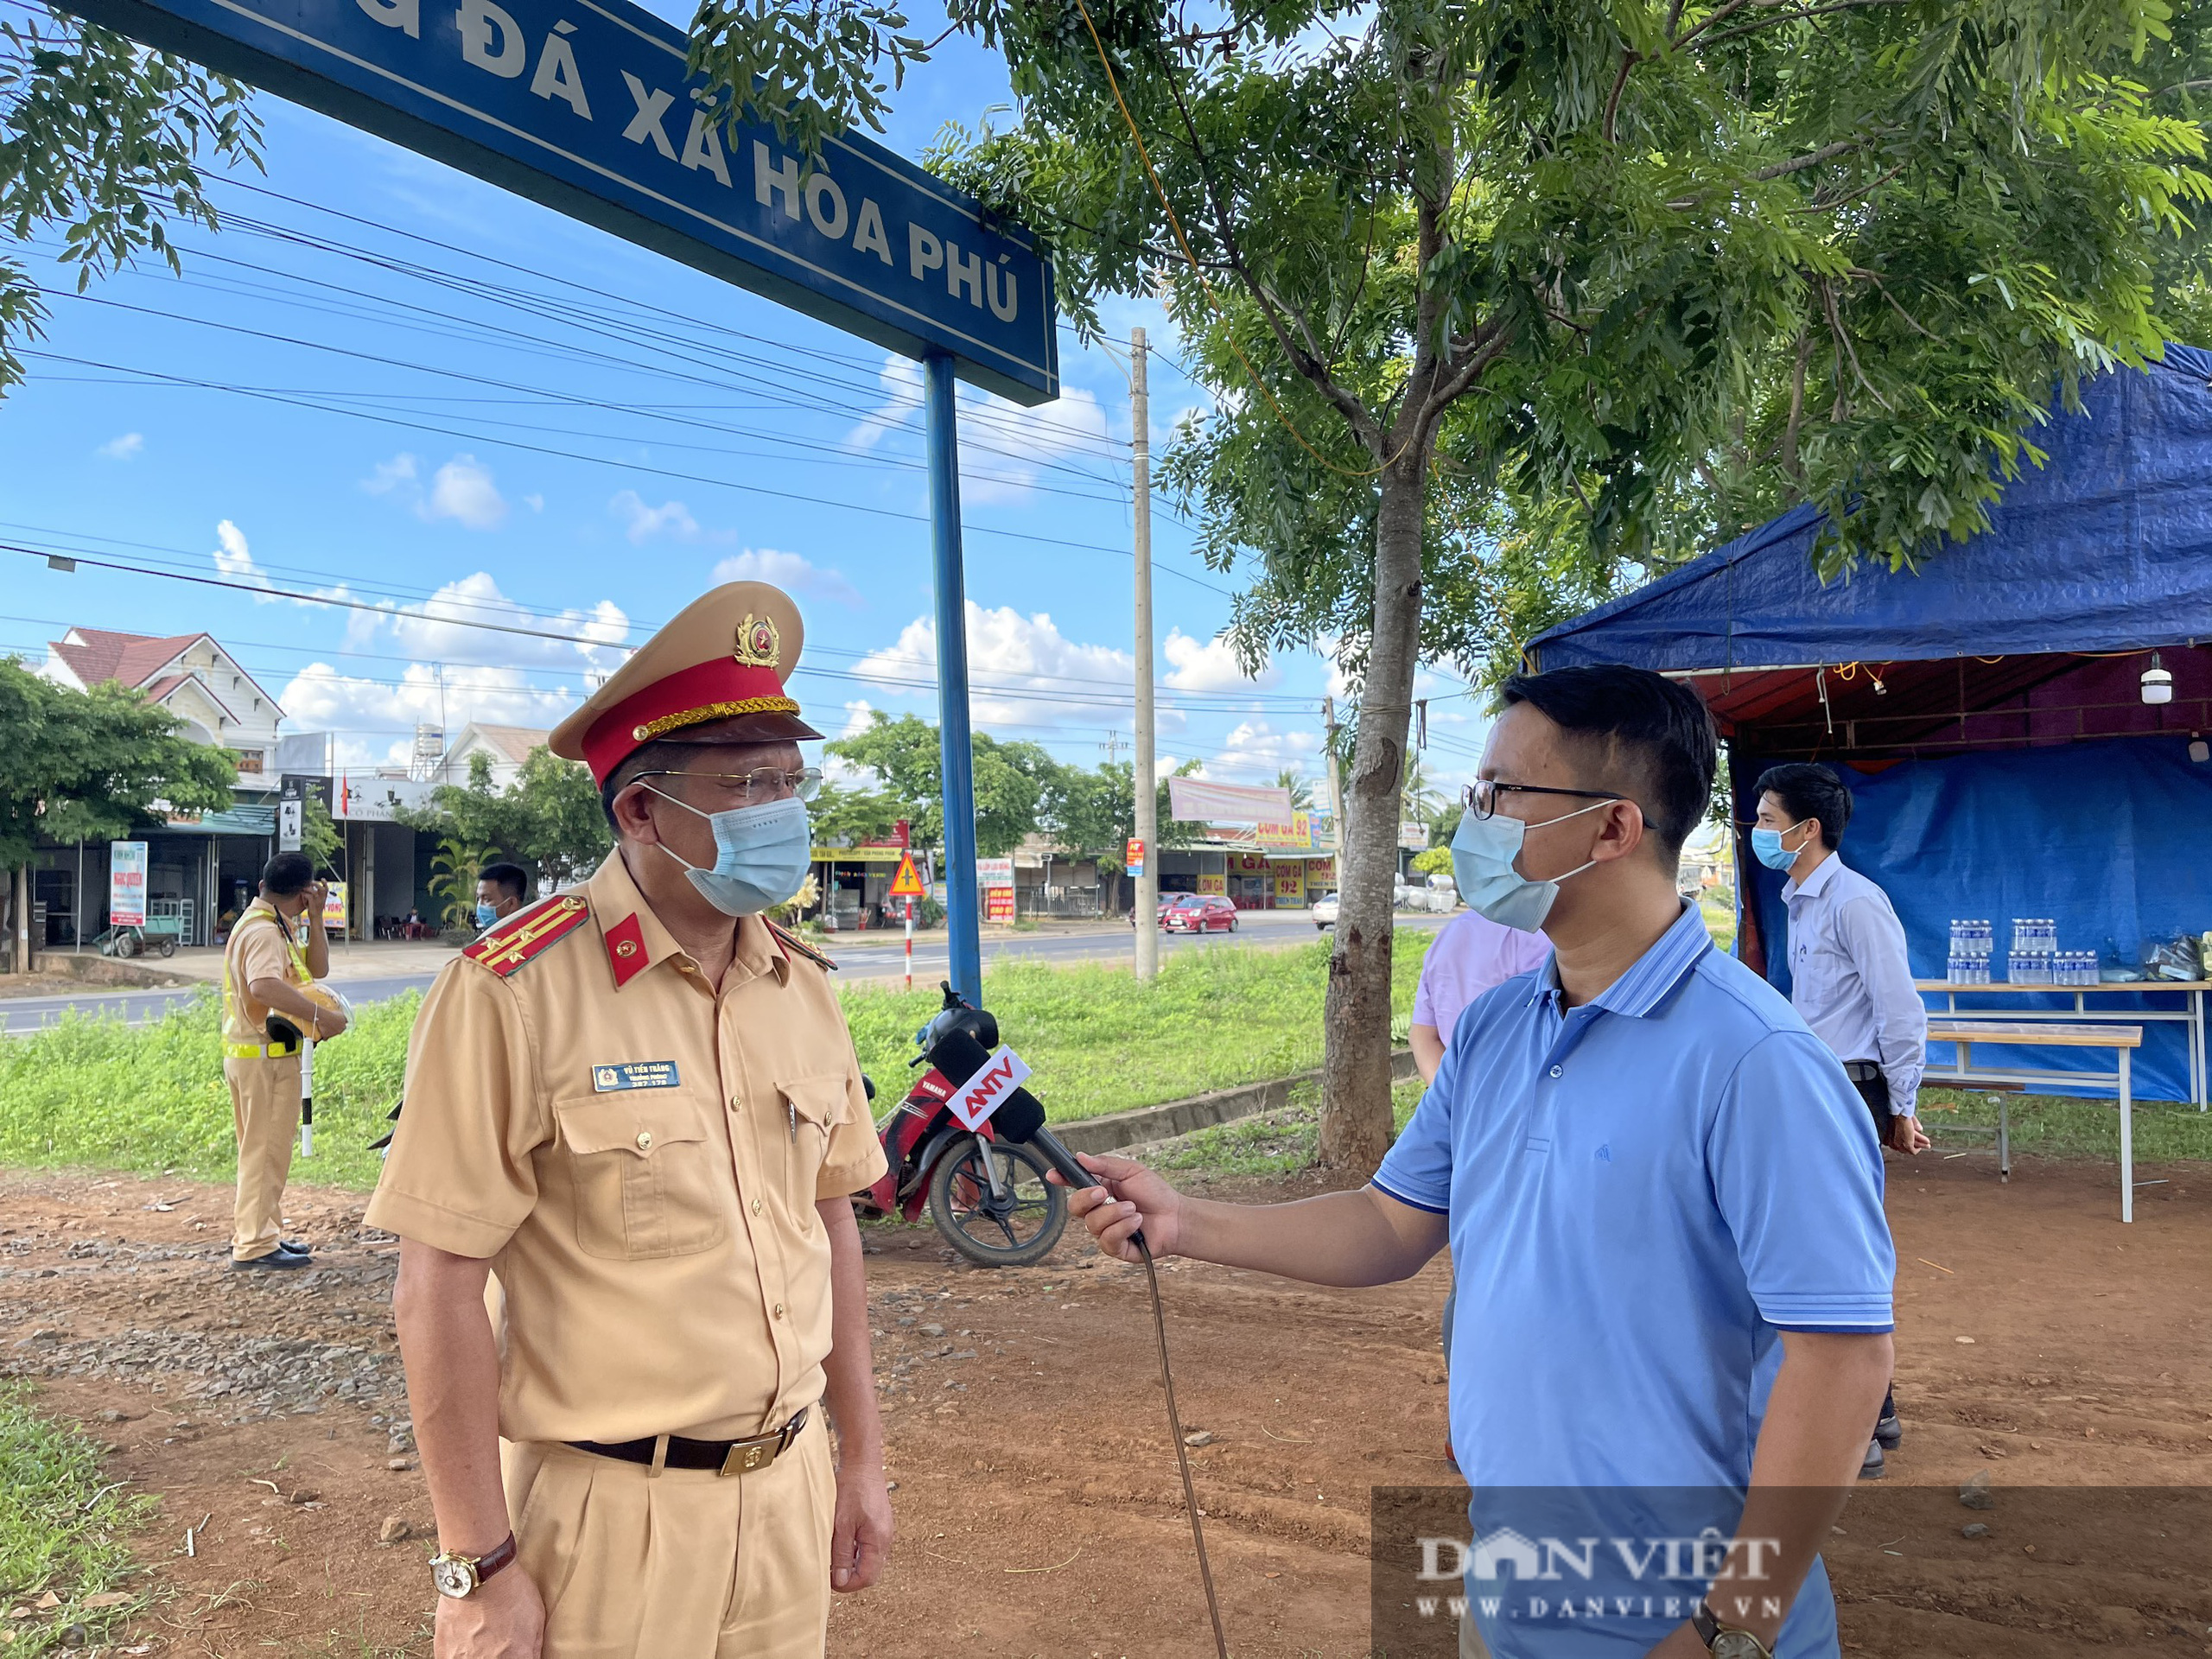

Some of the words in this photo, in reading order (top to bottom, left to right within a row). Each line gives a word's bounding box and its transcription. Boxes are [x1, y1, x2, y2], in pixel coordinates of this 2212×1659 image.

[455, 0, 594, 122] ĐÁ
[909, 221, 1018, 323] PHÚ
[1296, 820, 1307, 836] 92
[1281, 880, 1298, 894] 92
[922, 1080, 947, 1097] YAMAHA
[964, 1055, 1014, 1120] ANTV
